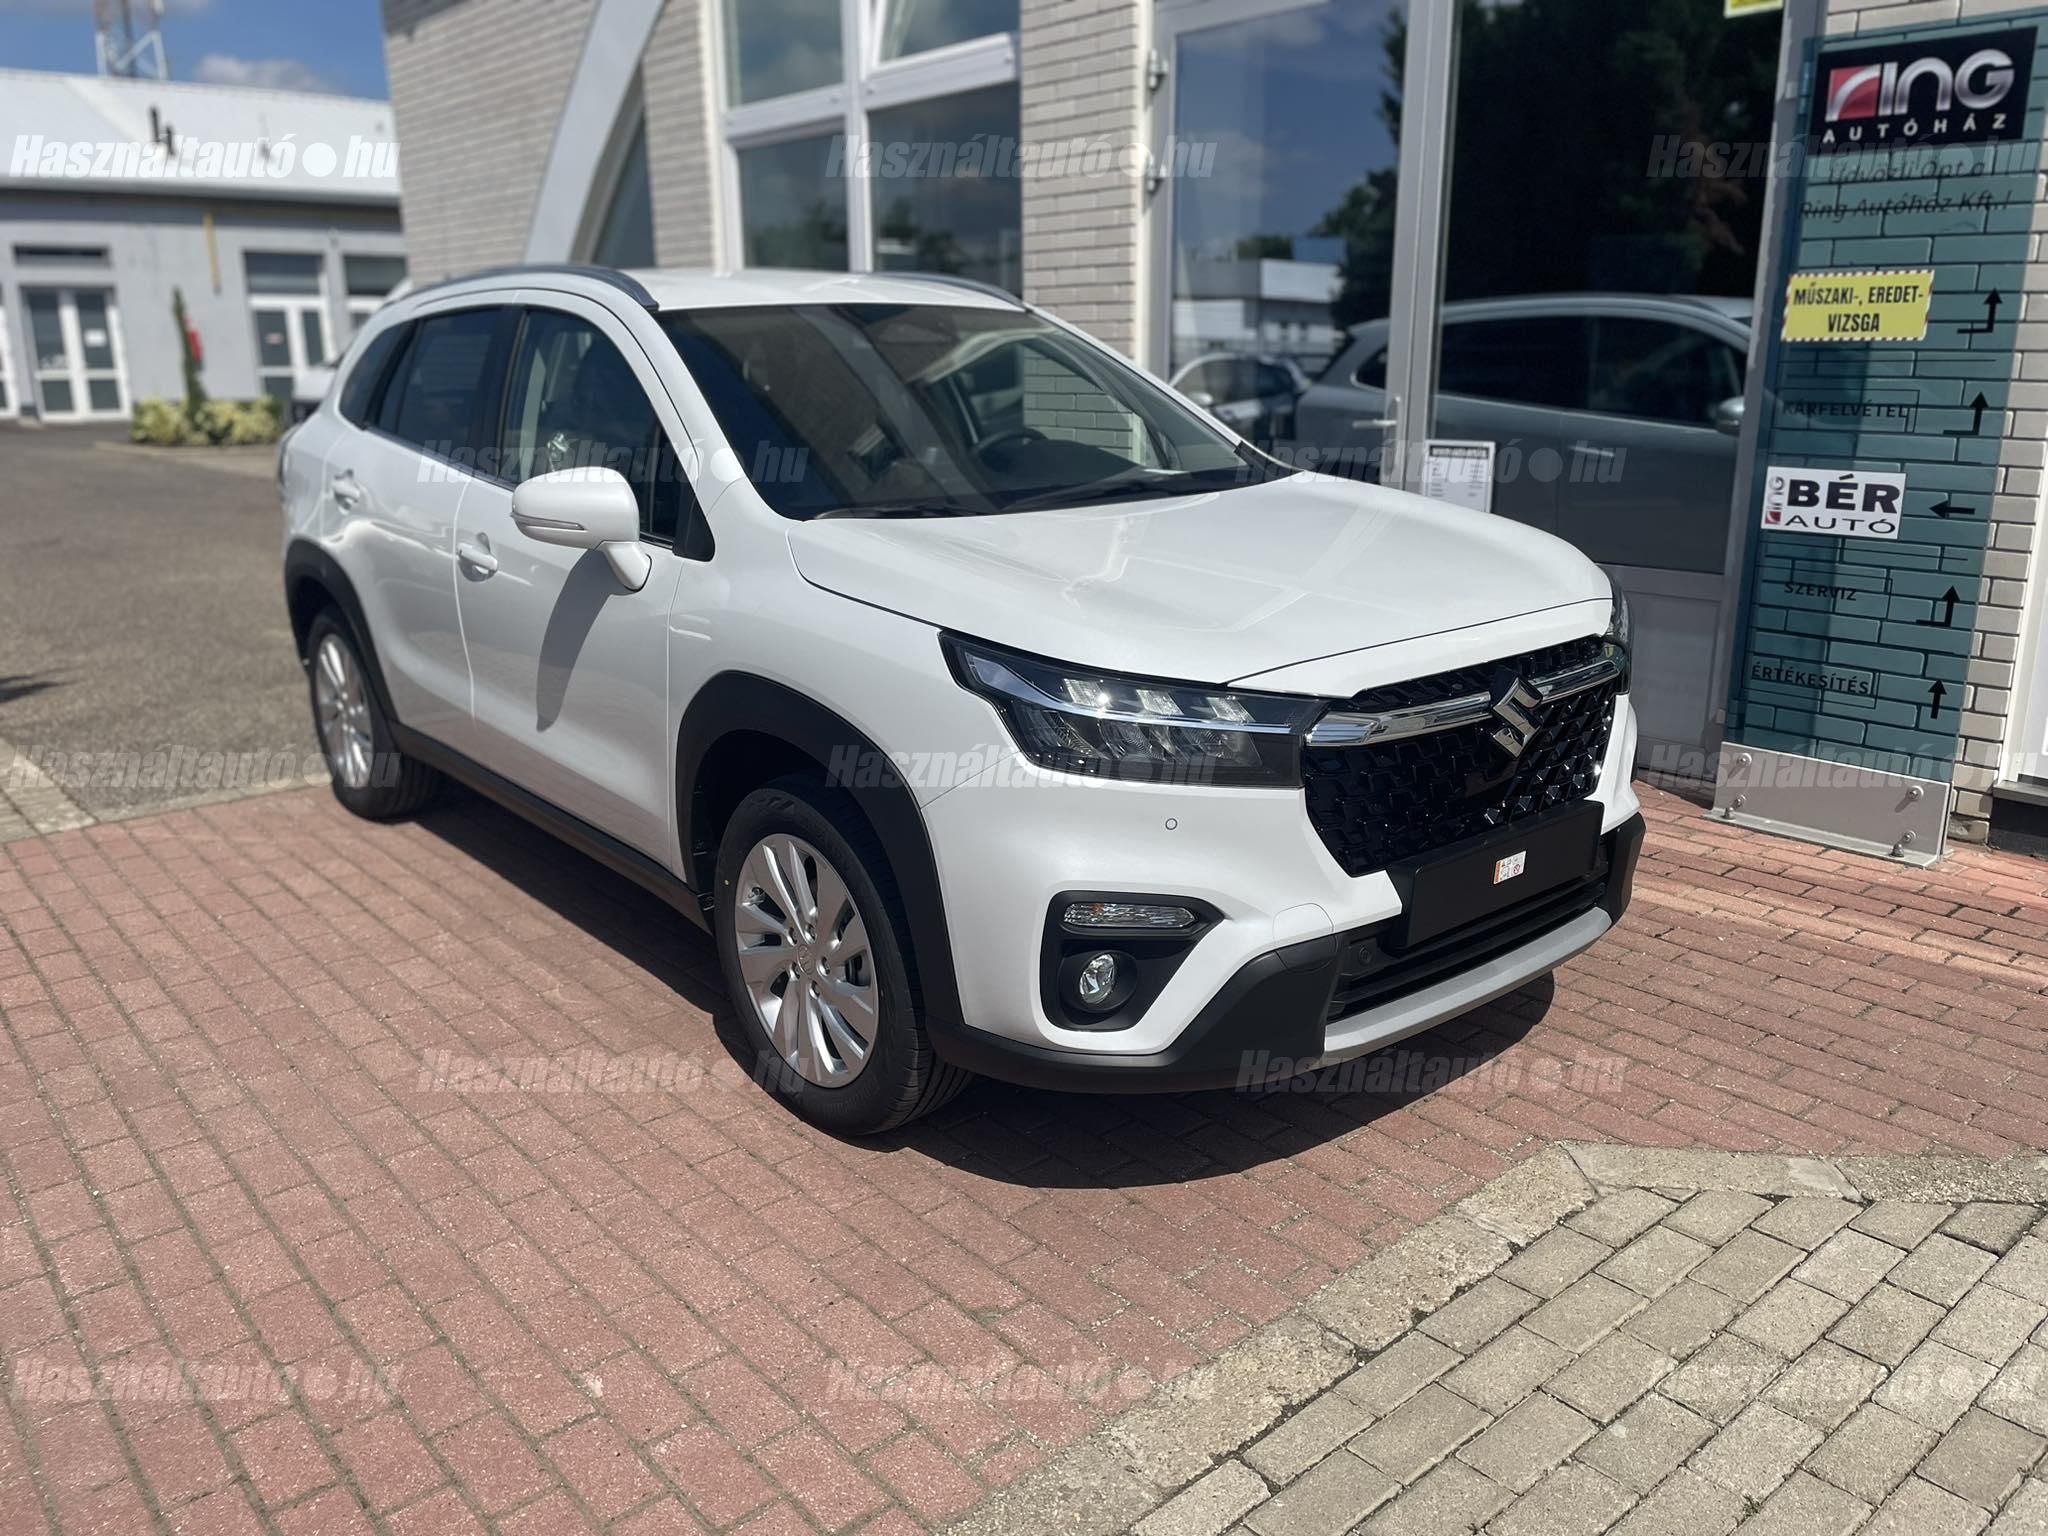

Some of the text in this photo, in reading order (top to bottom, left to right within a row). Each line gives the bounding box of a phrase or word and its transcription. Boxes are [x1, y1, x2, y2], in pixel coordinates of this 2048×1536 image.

[1822, 113, 2008, 144] AUTÓHÁZ
[1850, 194, 1952, 217] Autóház
[1867, 285, 1924, 304] EREDET-
[1827, 313, 1880, 333] VIZSGA
[1786, 473, 1900, 514] BÉR
[1784, 514, 1896, 534] AUTÓ
[1784, 582, 1857, 601] SZERVIZ
[1751, 660, 1870, 695] ÉRTÉKESÍTÉS
